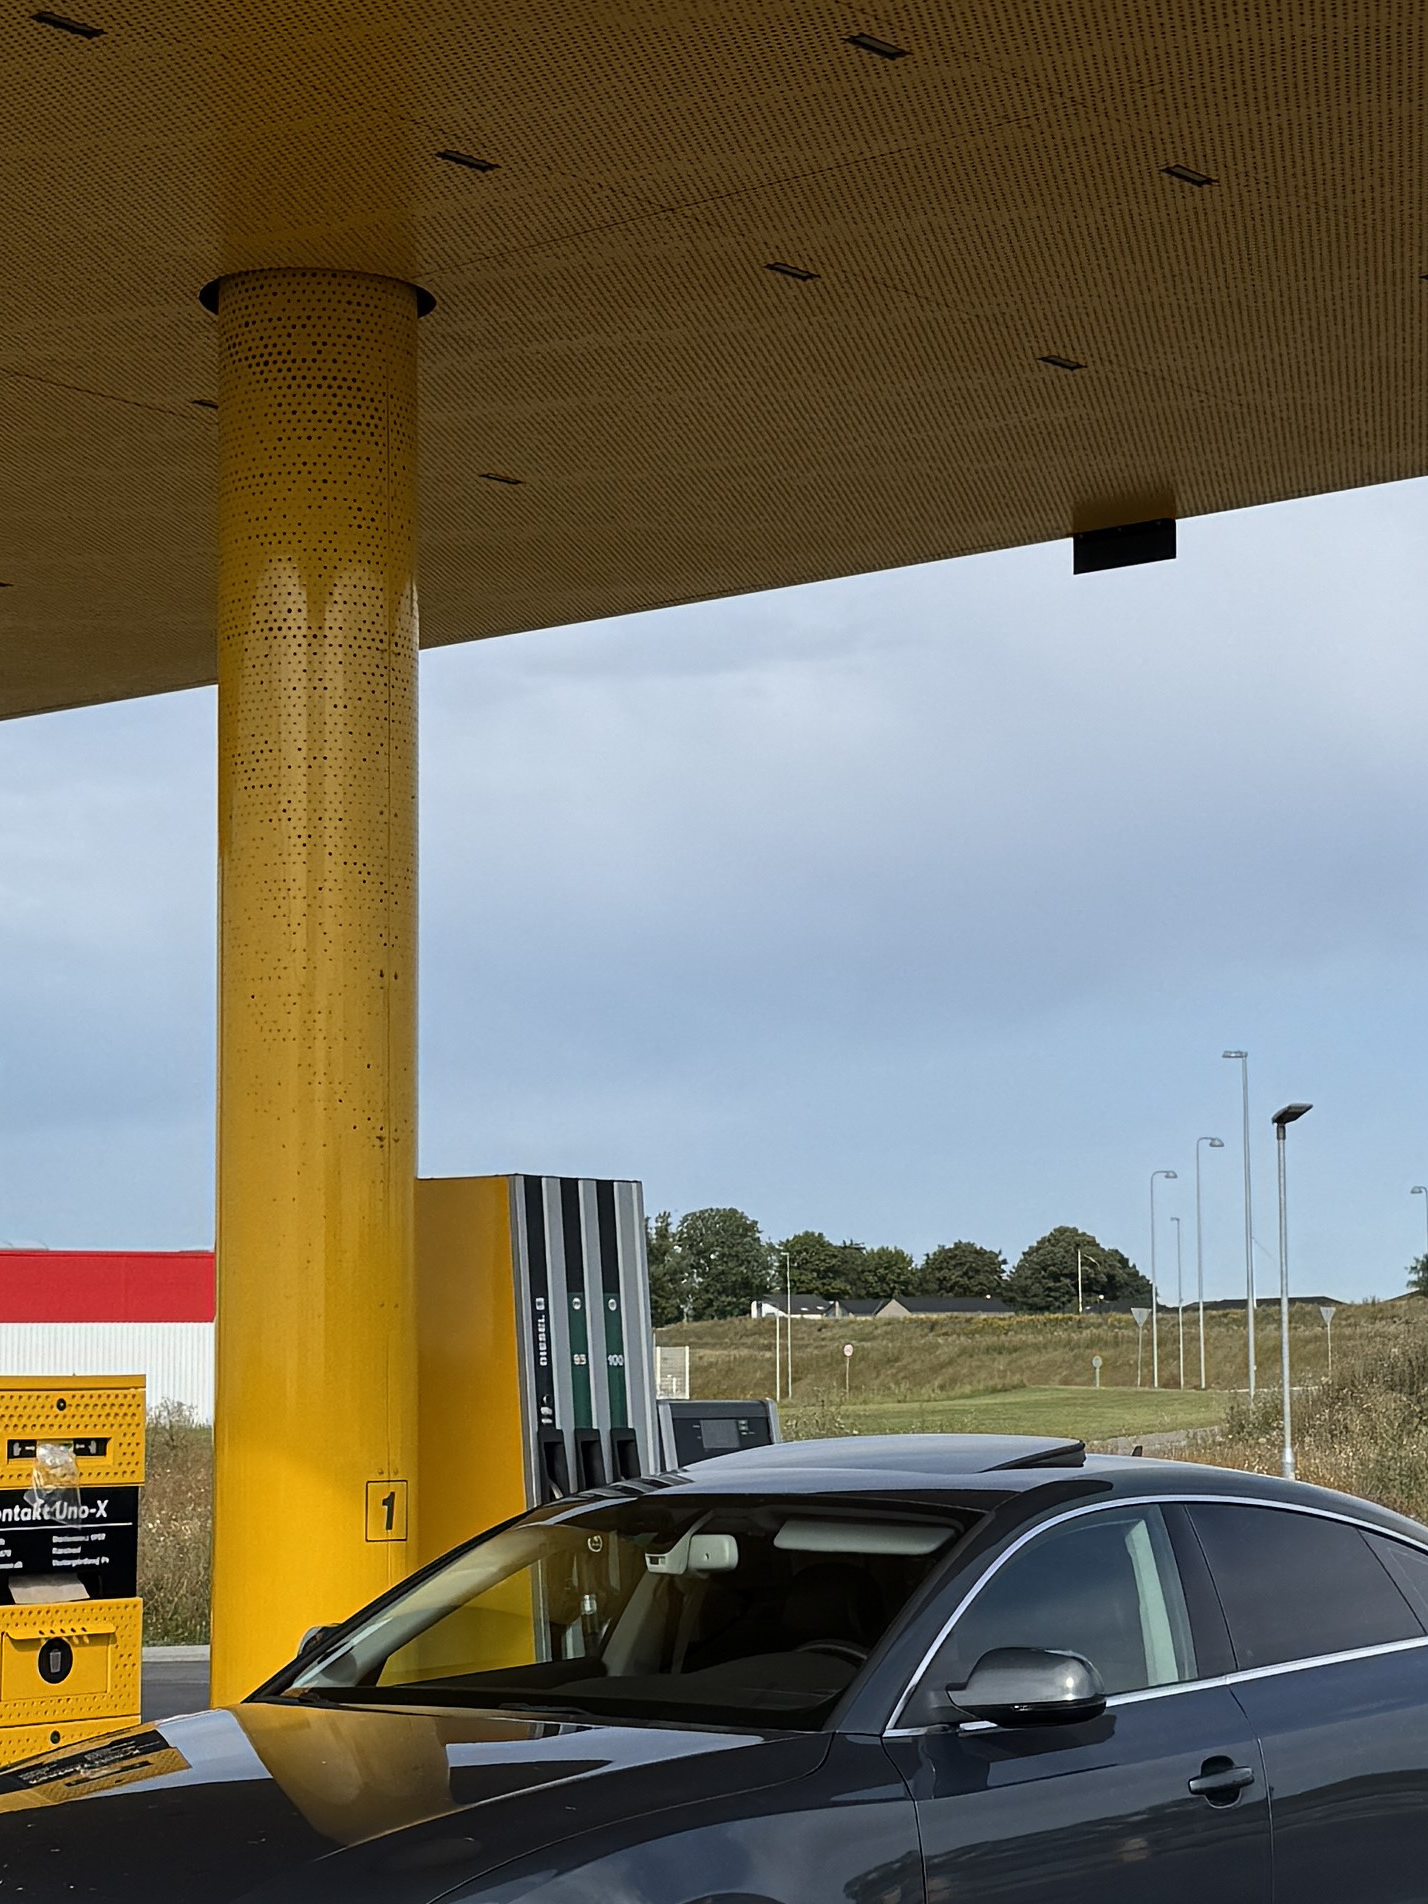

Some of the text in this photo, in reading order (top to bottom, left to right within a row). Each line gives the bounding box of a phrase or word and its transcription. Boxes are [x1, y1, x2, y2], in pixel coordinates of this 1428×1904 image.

[537, 1314, 548, 1366] DIESEL
[54, 1499, 109, 1520] Uno-X
[381, 1490, 396, 1531] 1
